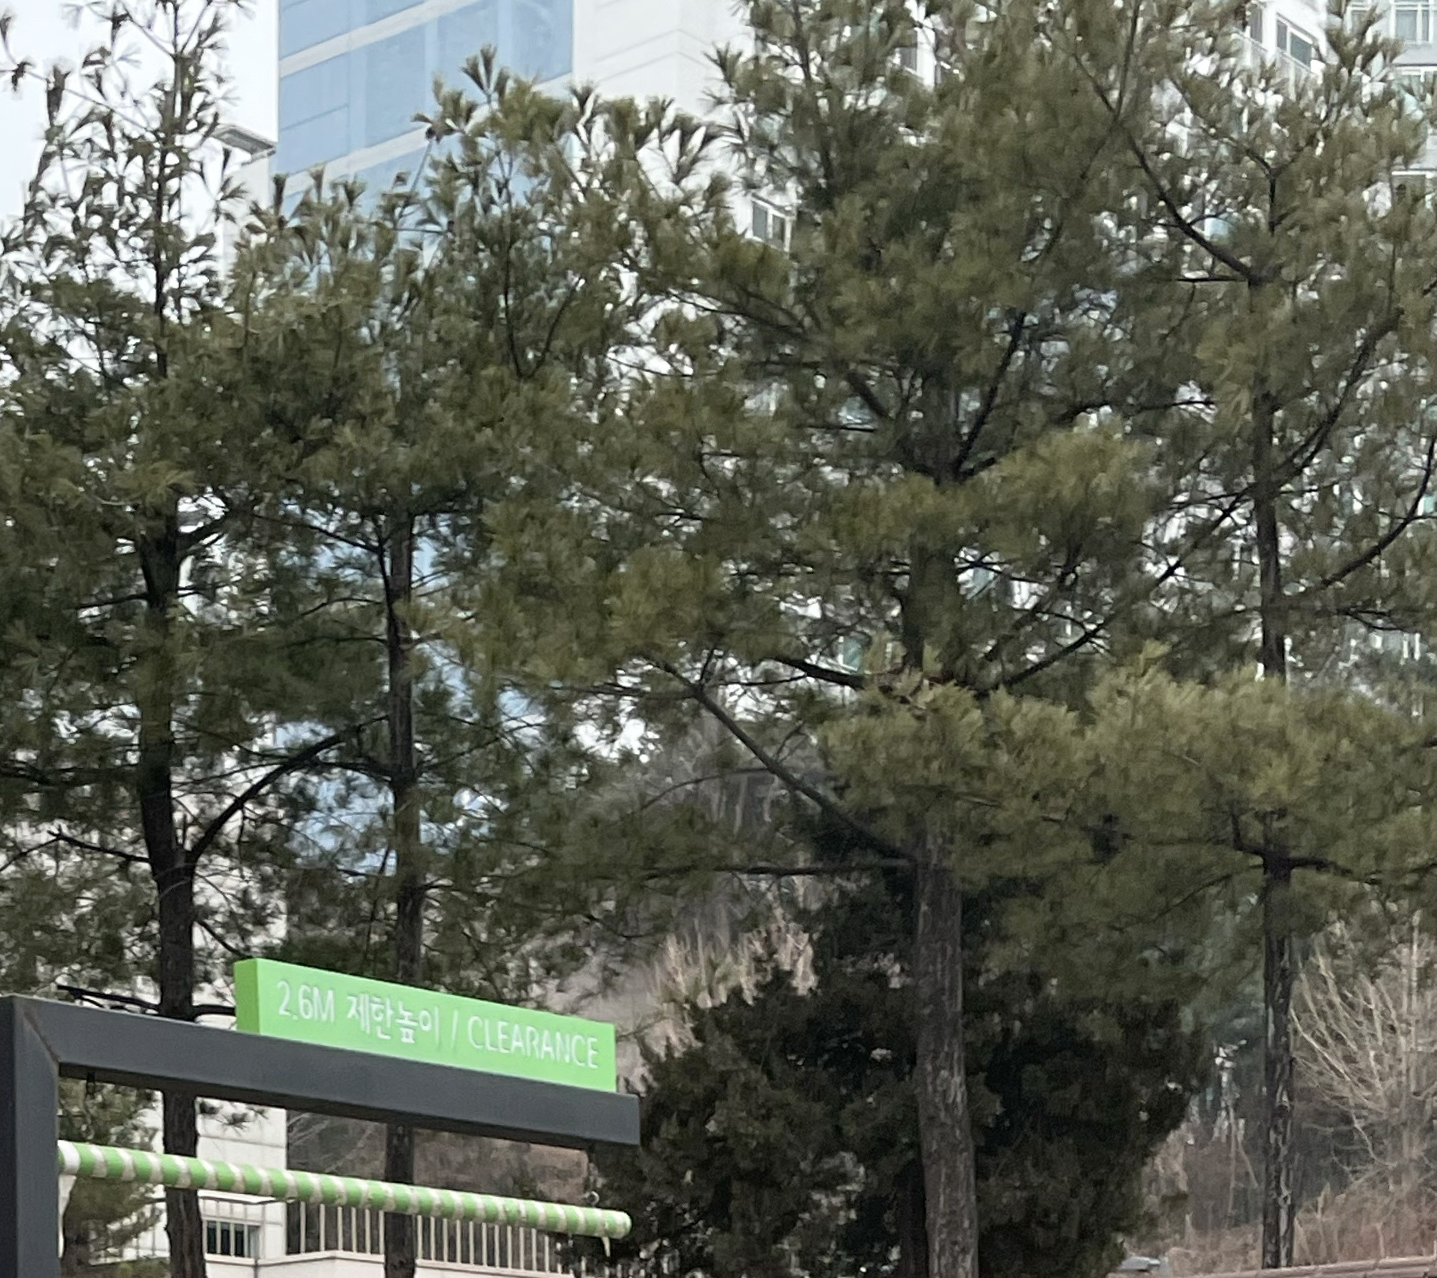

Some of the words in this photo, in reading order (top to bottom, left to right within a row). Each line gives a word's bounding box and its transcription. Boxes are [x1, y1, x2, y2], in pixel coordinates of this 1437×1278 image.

[276, 979, 335, 1023] 2.6M
[346, 993, 440, 1046] 제한높이
[467, 1015, 599, 1069] CLEARANCE
